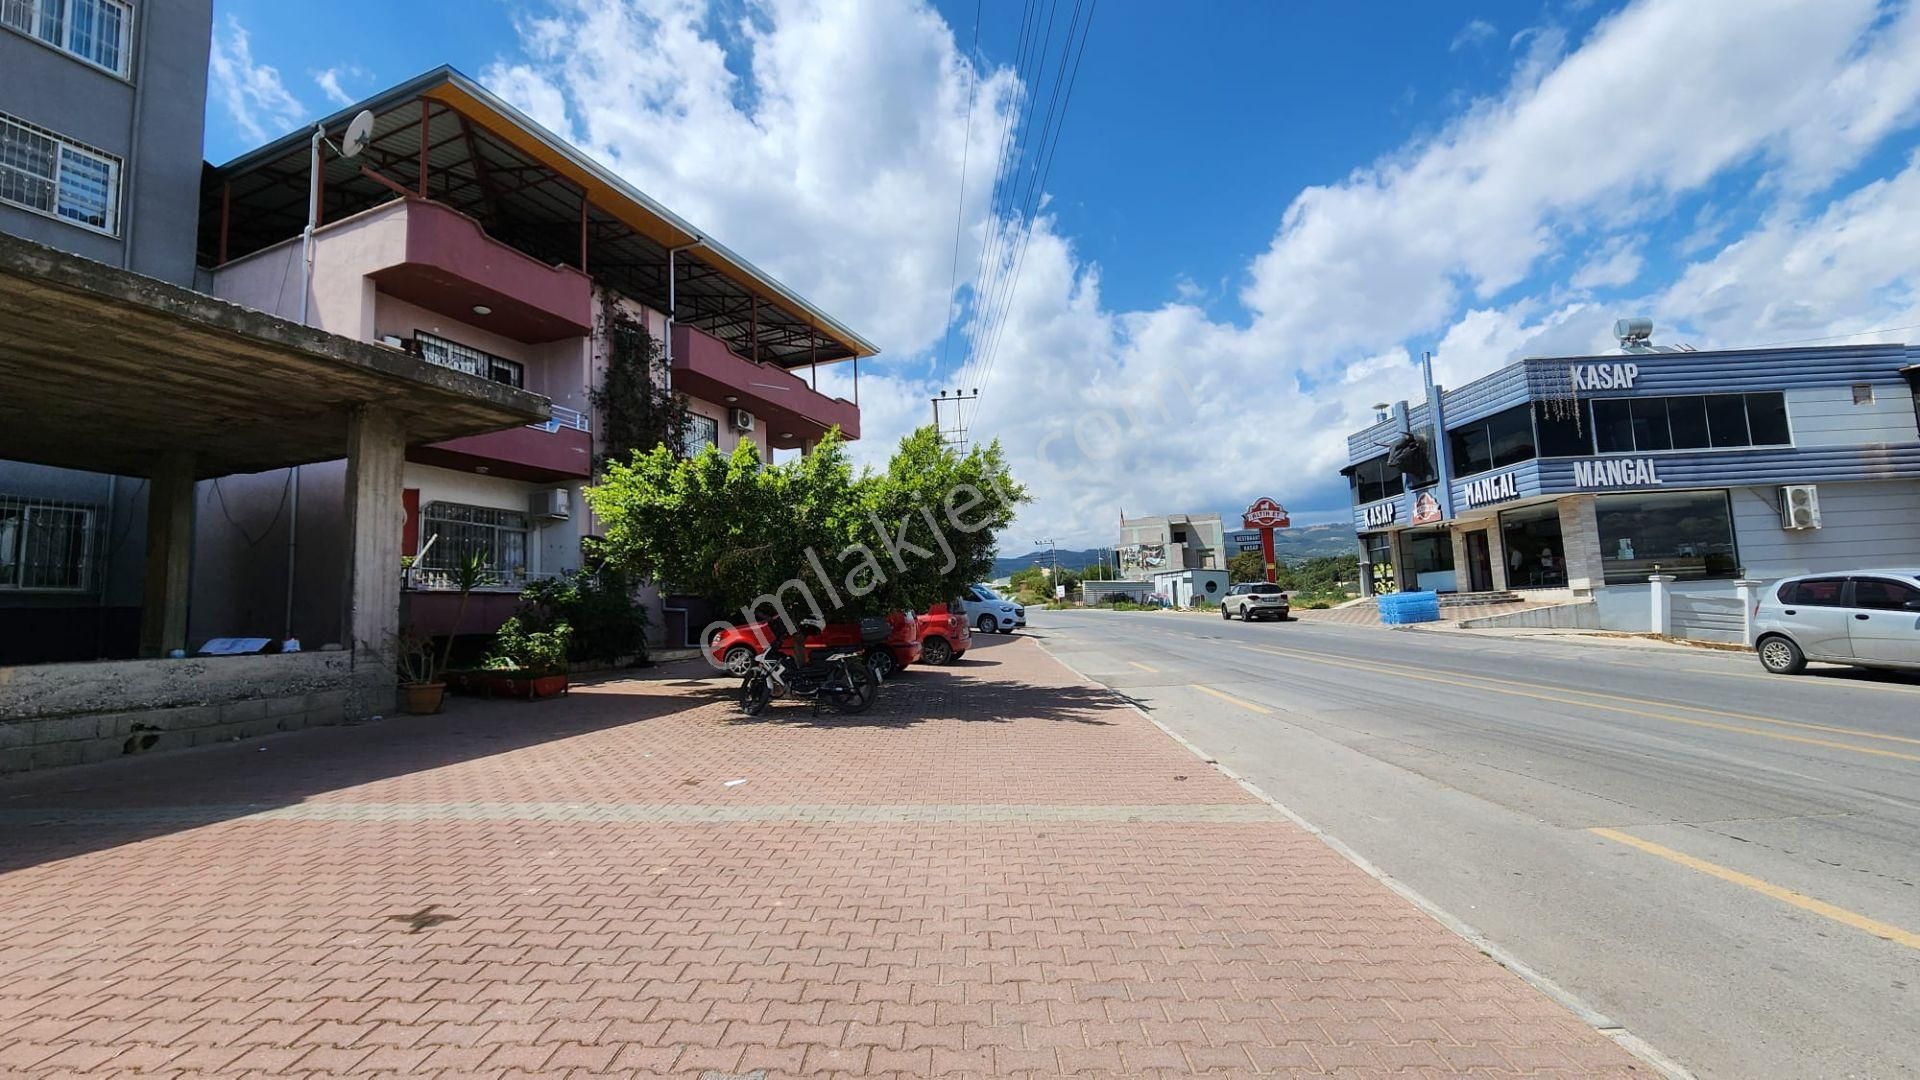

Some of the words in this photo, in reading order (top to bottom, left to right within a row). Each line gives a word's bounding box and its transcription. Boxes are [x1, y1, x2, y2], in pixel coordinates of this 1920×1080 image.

[1571, 363, 1638, 390] KASAP
[1573, 459, 1662, 487] MANGAL
[1464, 473, 1518, 505] MANGAL
[1364, 502, 1394, 528] KASAP
